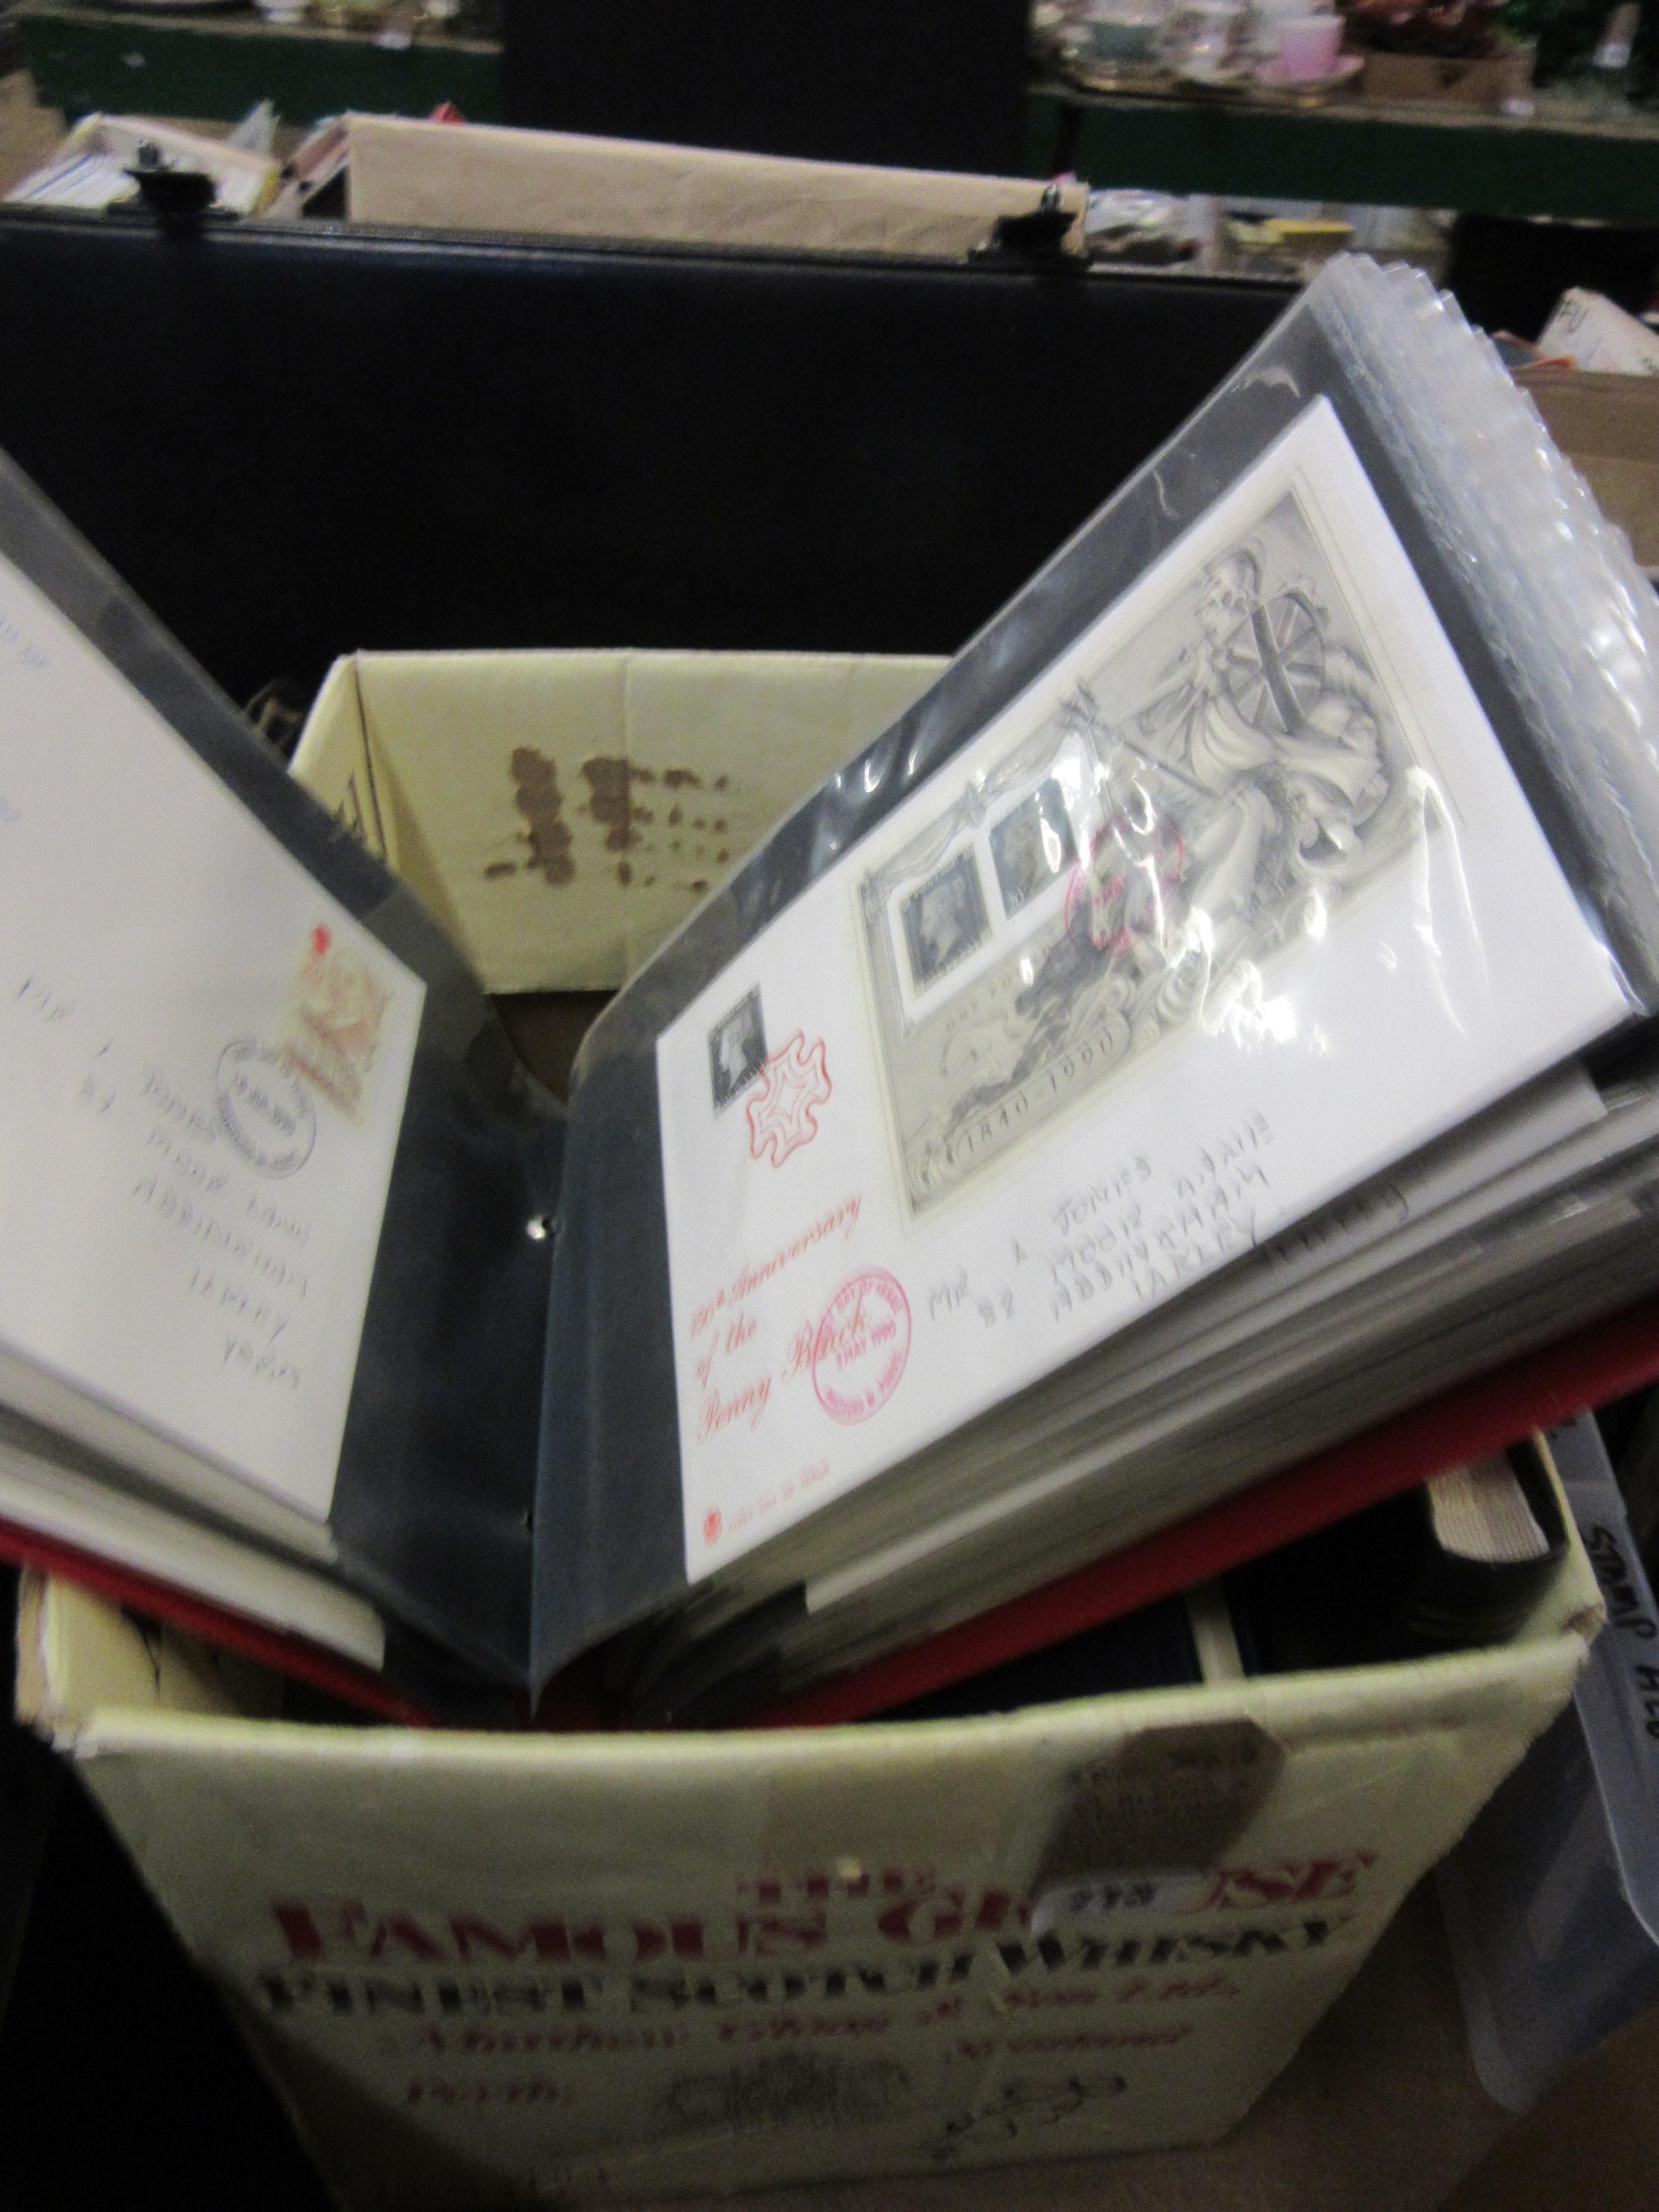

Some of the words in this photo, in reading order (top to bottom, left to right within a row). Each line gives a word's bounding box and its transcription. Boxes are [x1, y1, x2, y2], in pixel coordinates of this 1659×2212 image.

[729, 1194, 861, 1307] Anniversary
[697, 1328, 719, 1388] of
[726, 1310, 757, 1353] the
[697, 1374, 771, 1442] Penny
[270, 1898, 827, 1963] FAMOUS
